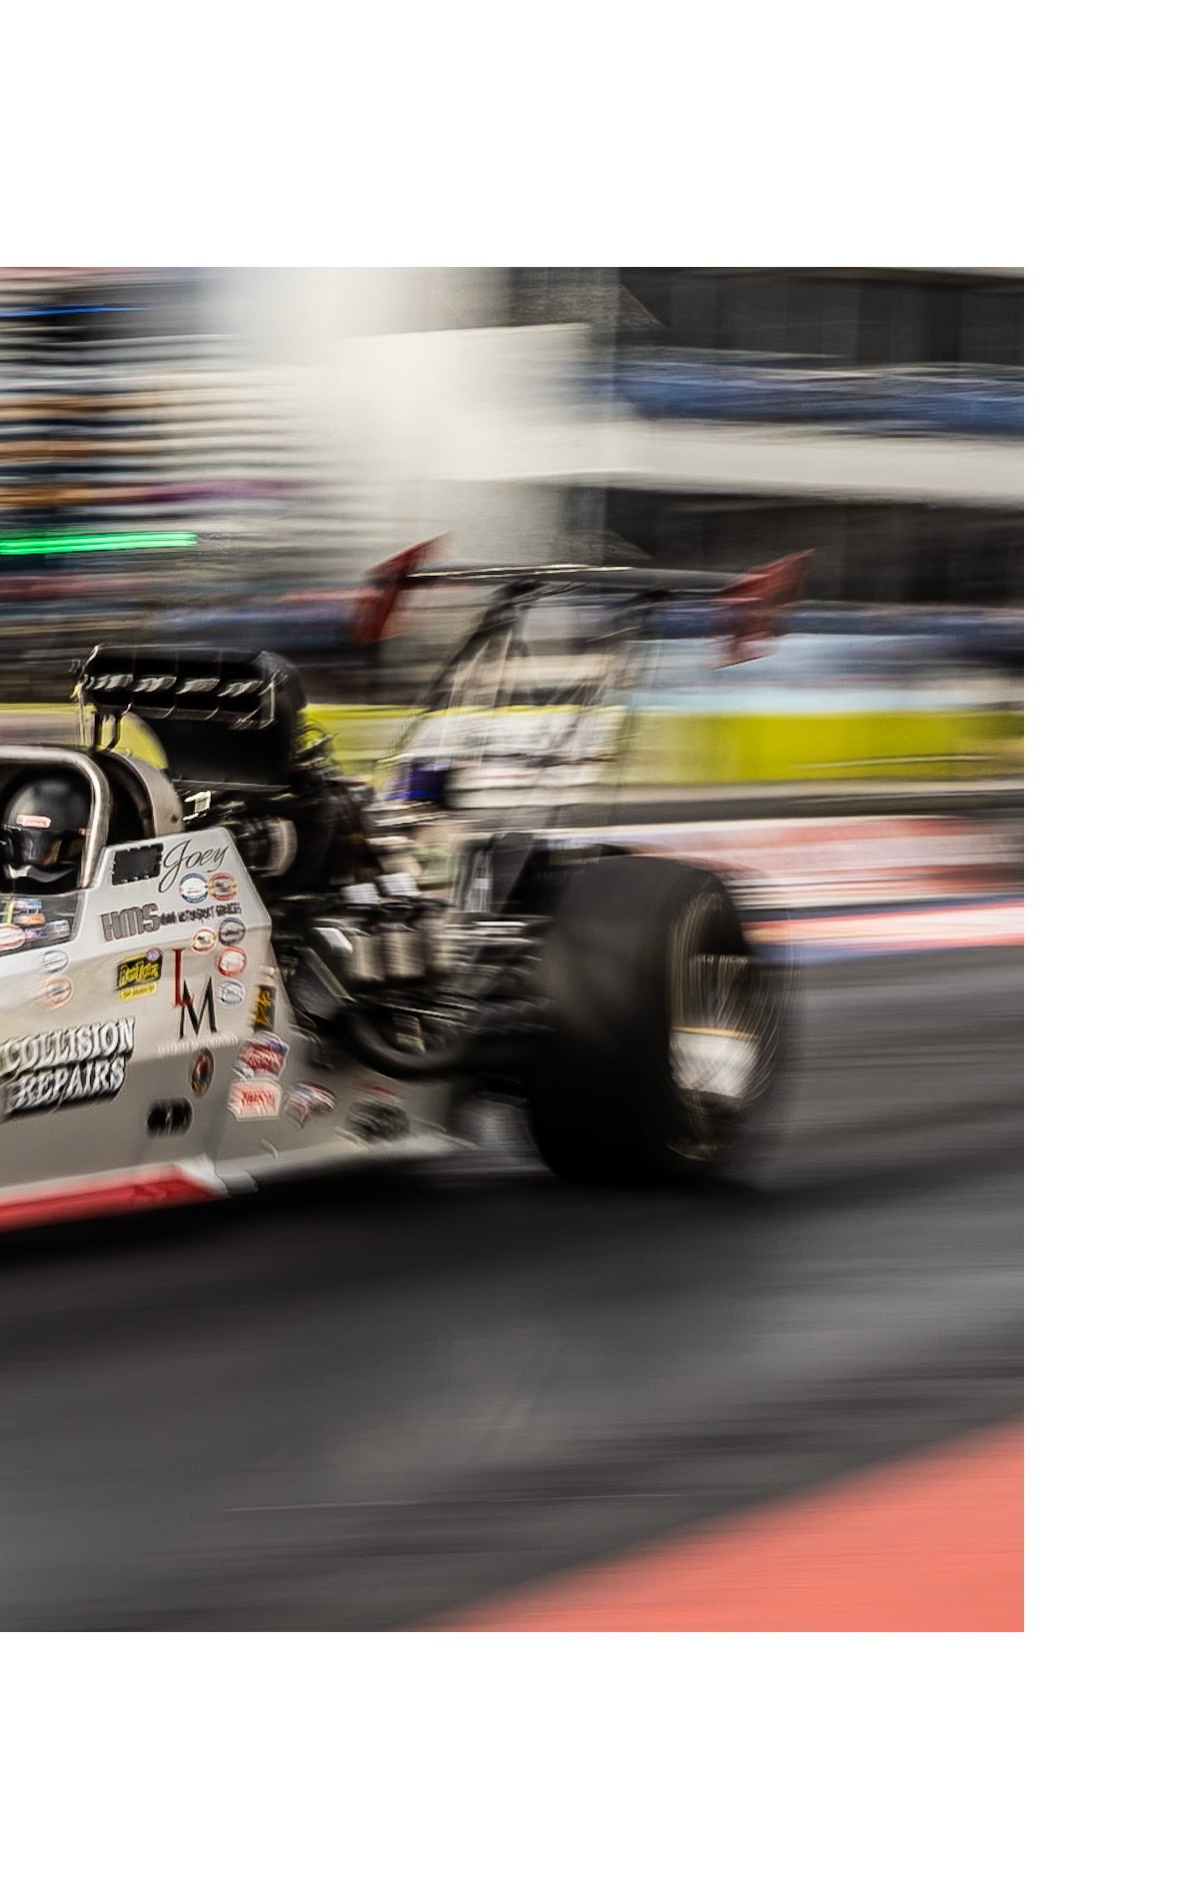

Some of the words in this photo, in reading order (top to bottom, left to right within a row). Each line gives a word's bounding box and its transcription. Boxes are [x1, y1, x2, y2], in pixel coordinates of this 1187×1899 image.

[158, 839, 230, 893] Joey
[100, 903, 161, 941] HMS
[4, 1056, 126, 1115] REPAIRS
